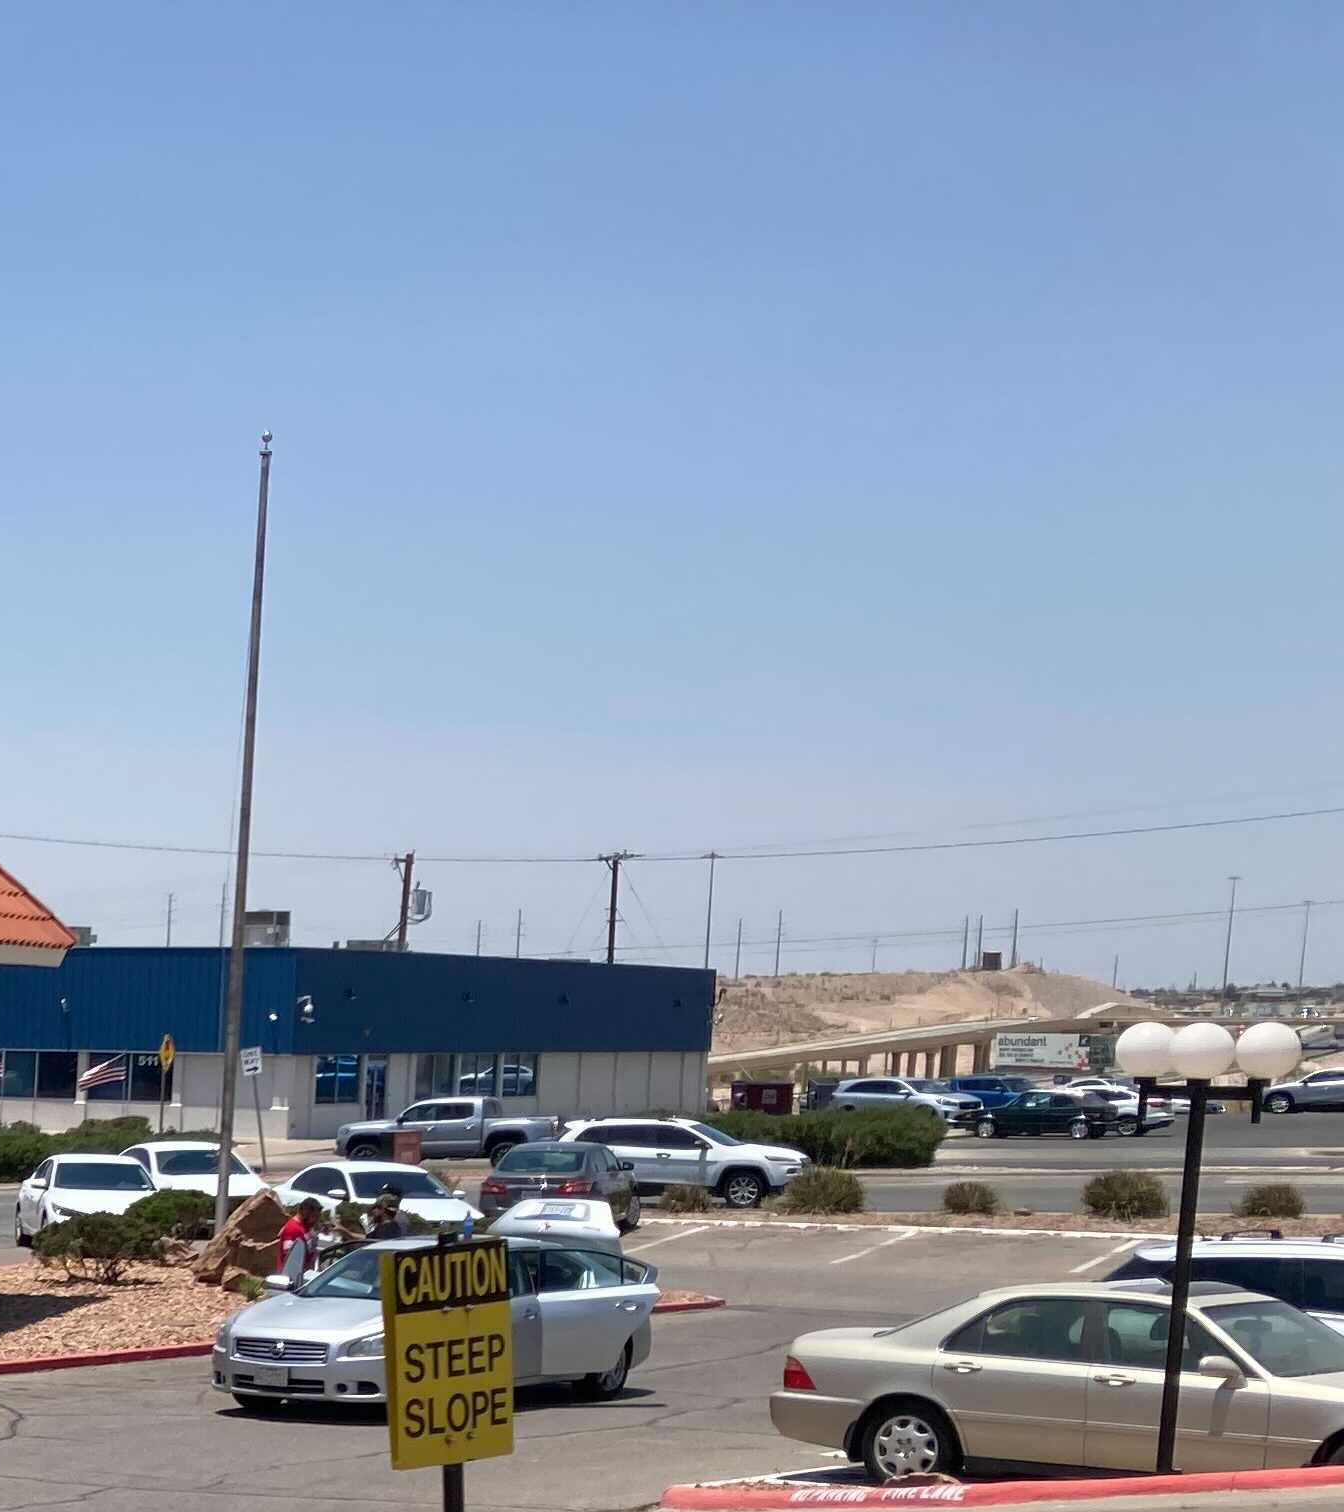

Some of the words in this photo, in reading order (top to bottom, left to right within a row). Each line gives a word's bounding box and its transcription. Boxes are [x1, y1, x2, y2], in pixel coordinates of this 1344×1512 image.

[998, 1036, 1047, 1047] abundant
[397, 1247, 508, 1306] CAUTION
[404, 1333, 506, 1384] STEEP
[404, 1387, 508, 1439] SLOPE
